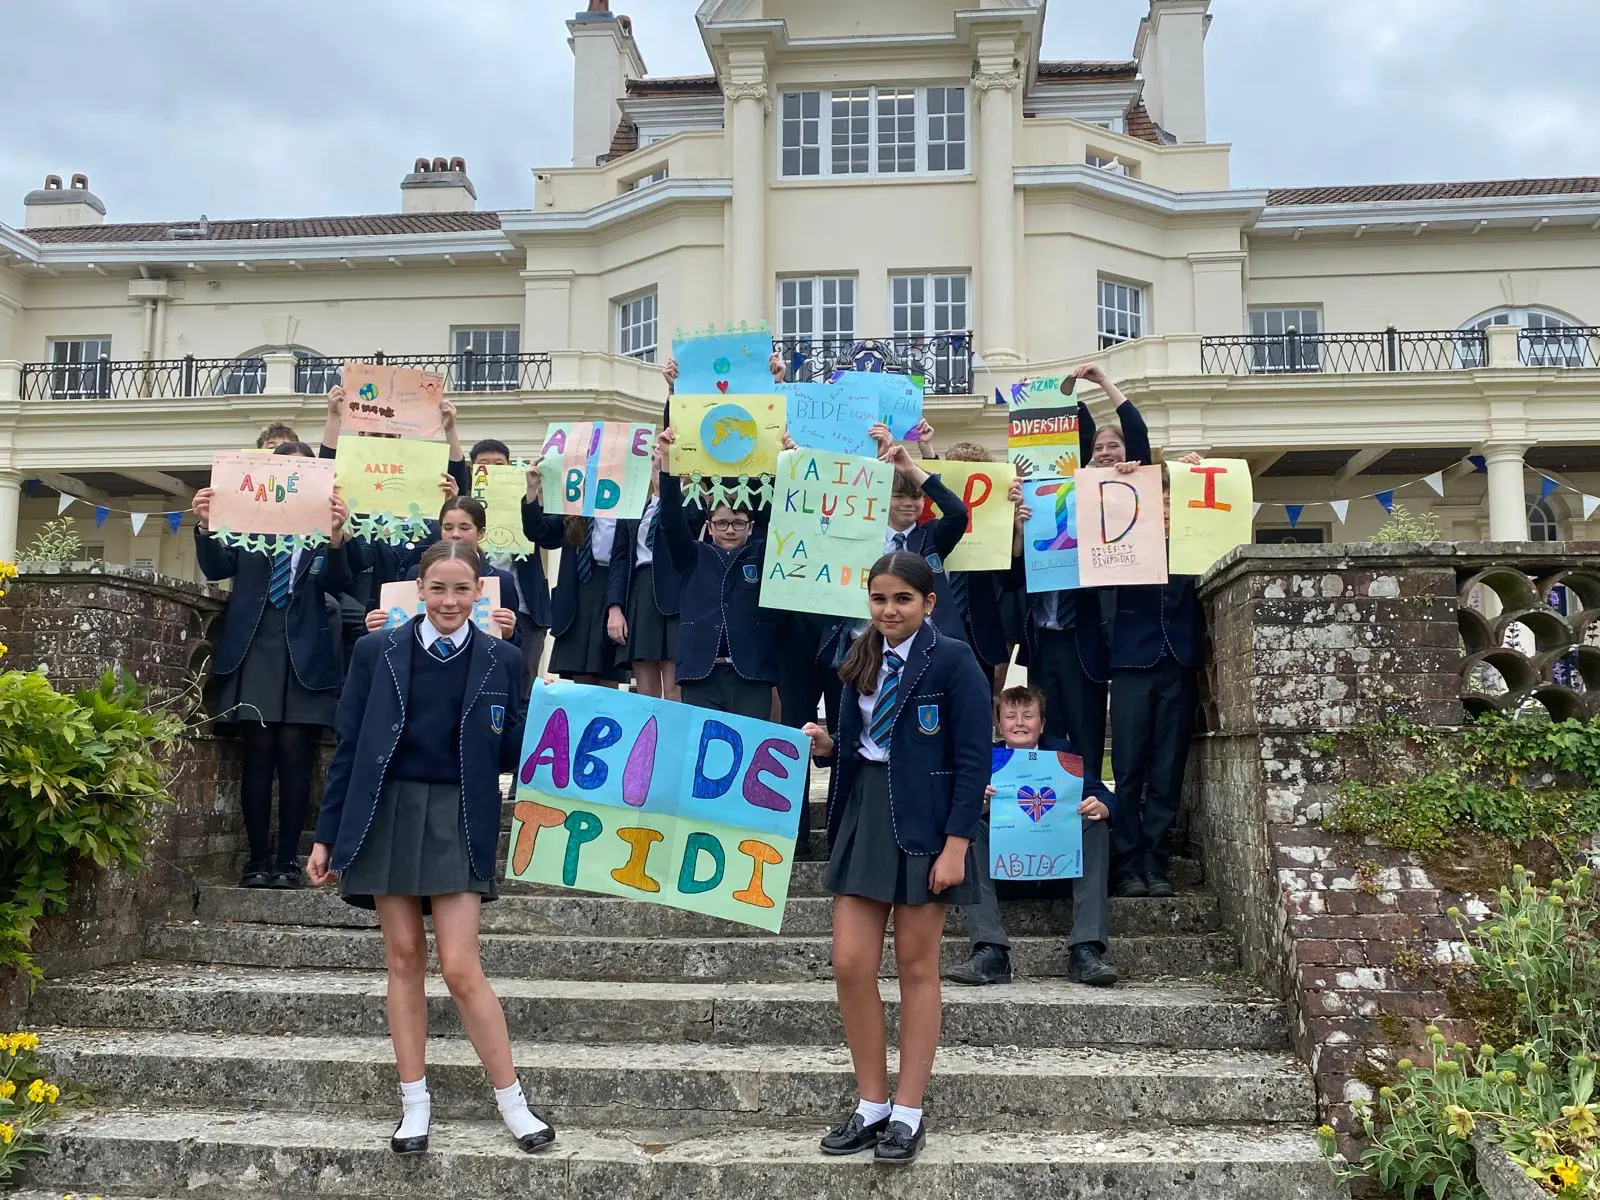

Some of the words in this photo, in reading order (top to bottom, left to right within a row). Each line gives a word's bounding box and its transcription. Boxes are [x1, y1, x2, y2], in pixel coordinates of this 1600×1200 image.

[1031, 378, 1060, 392] AZADE
[1012, 414, 1077, 436] DIVERSITÄT
[788, 454, 820, 481] YA
[832, 461, 884, 489] IN-
[785, 488, 887, 521] KLUSI-
[1188, 467, 1232, 512] I
[1099, 480, 1140, 544] D
[773, 529, 808, 559] YA
